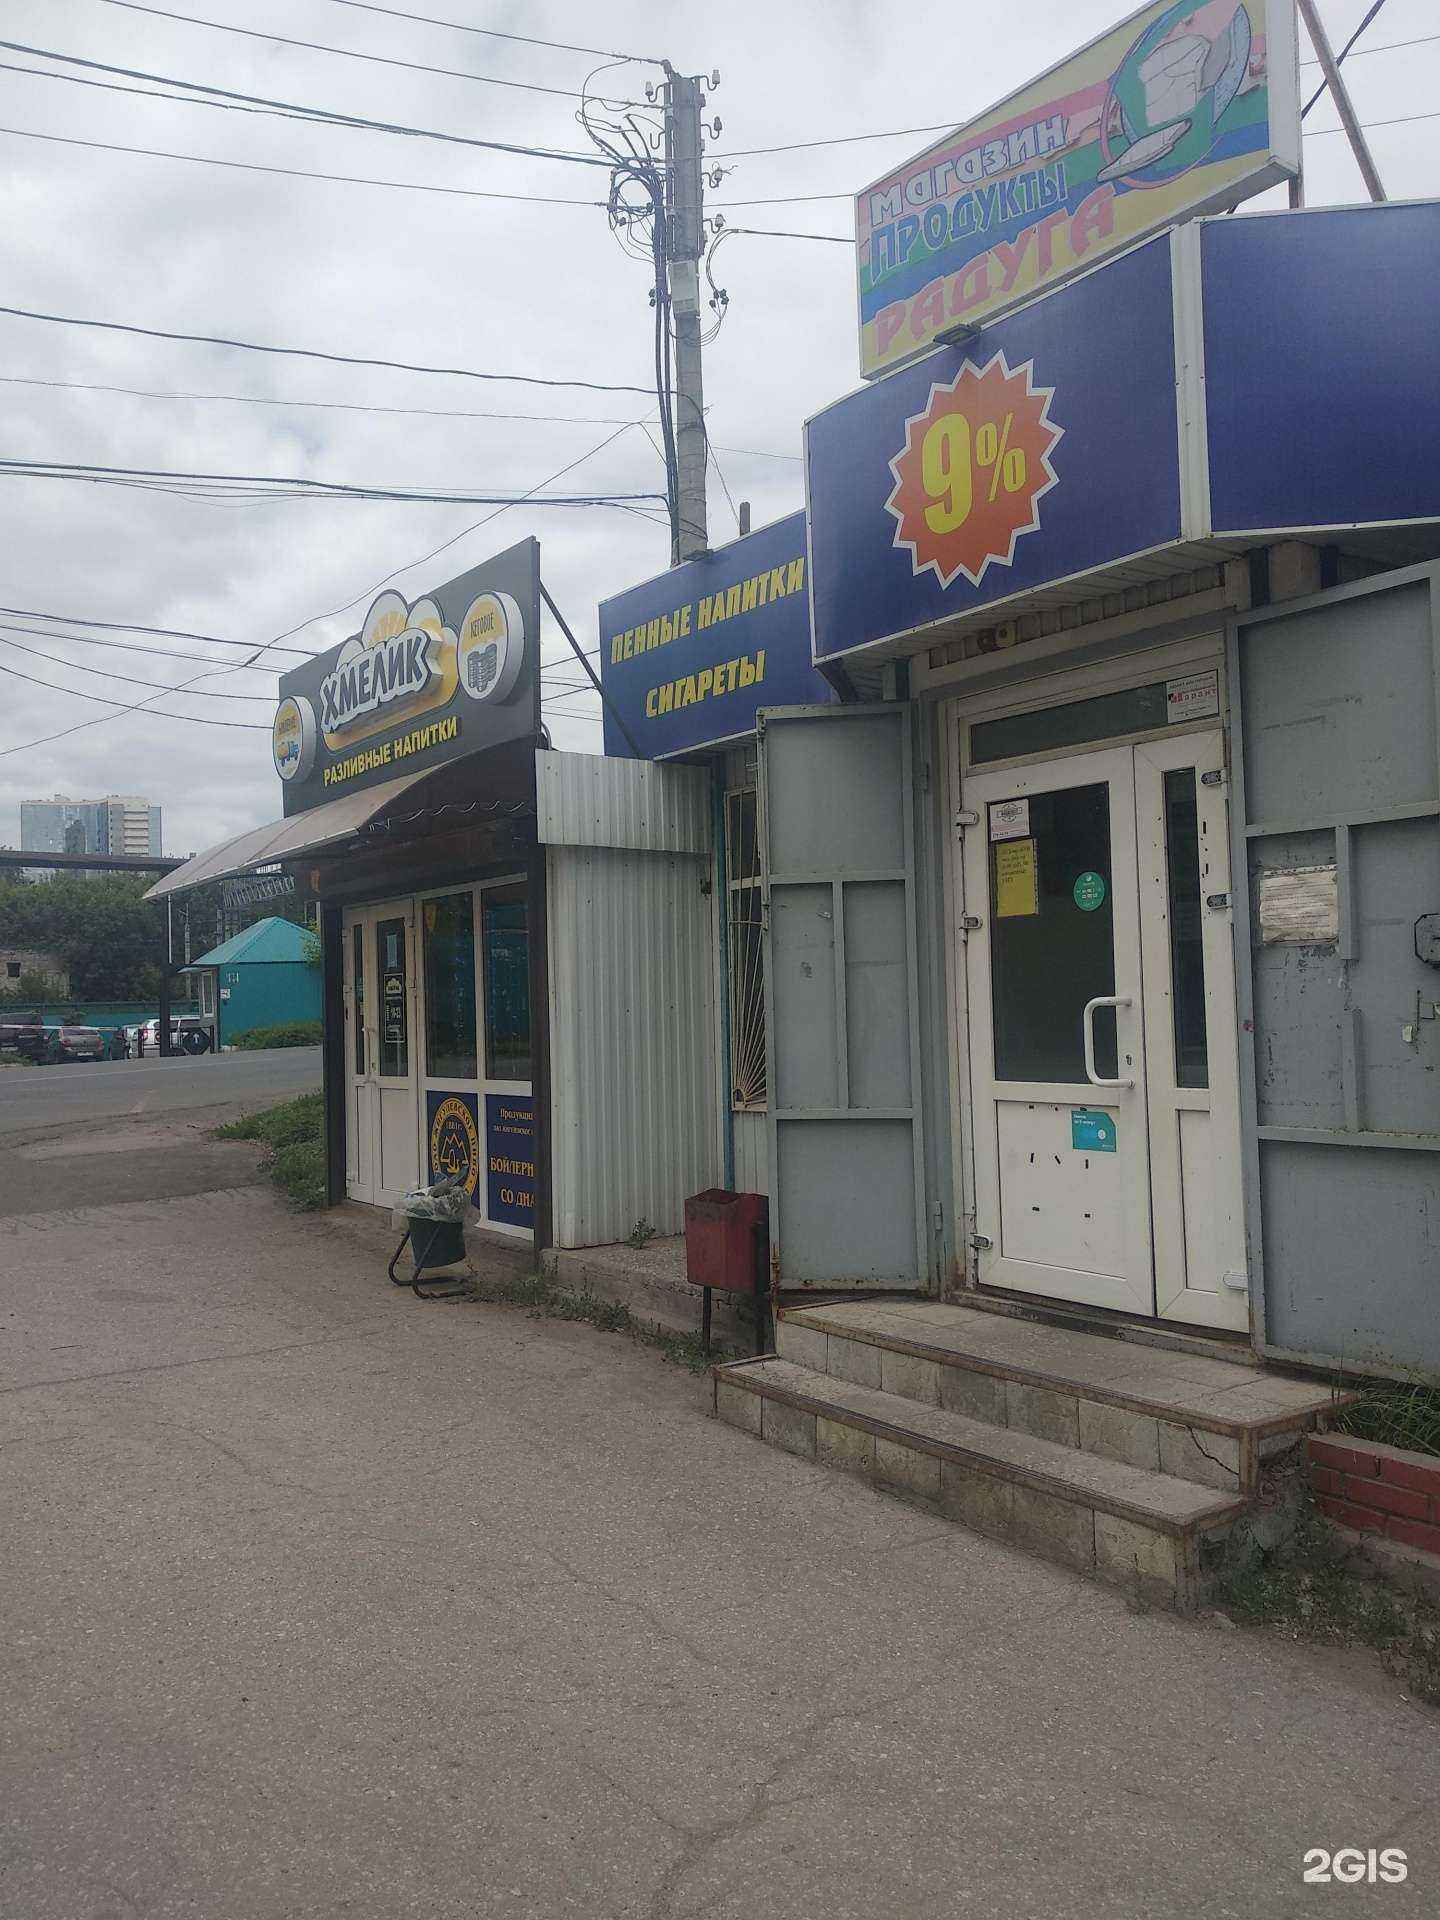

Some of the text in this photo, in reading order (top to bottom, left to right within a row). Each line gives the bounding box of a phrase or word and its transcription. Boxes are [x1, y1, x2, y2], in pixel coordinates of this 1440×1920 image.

[869, 162, 1068, 285] ПРОДУКТЫ
[873, 185, 1118, 357] РАДУГА
[921, 412, 1027, 535] 9%
[610, 557, 806, 664] ПЕННЫЕ НАПИТКИ
[322, 634, 424, 727] ХМЕЛИК
[644, 649, 766, 719] СИГАРЕТЫ
[323, 716, 458, 787] РАЗЛИВНЫЕ НАПИТКИ
[500, 1187, 514, 1204] СО
